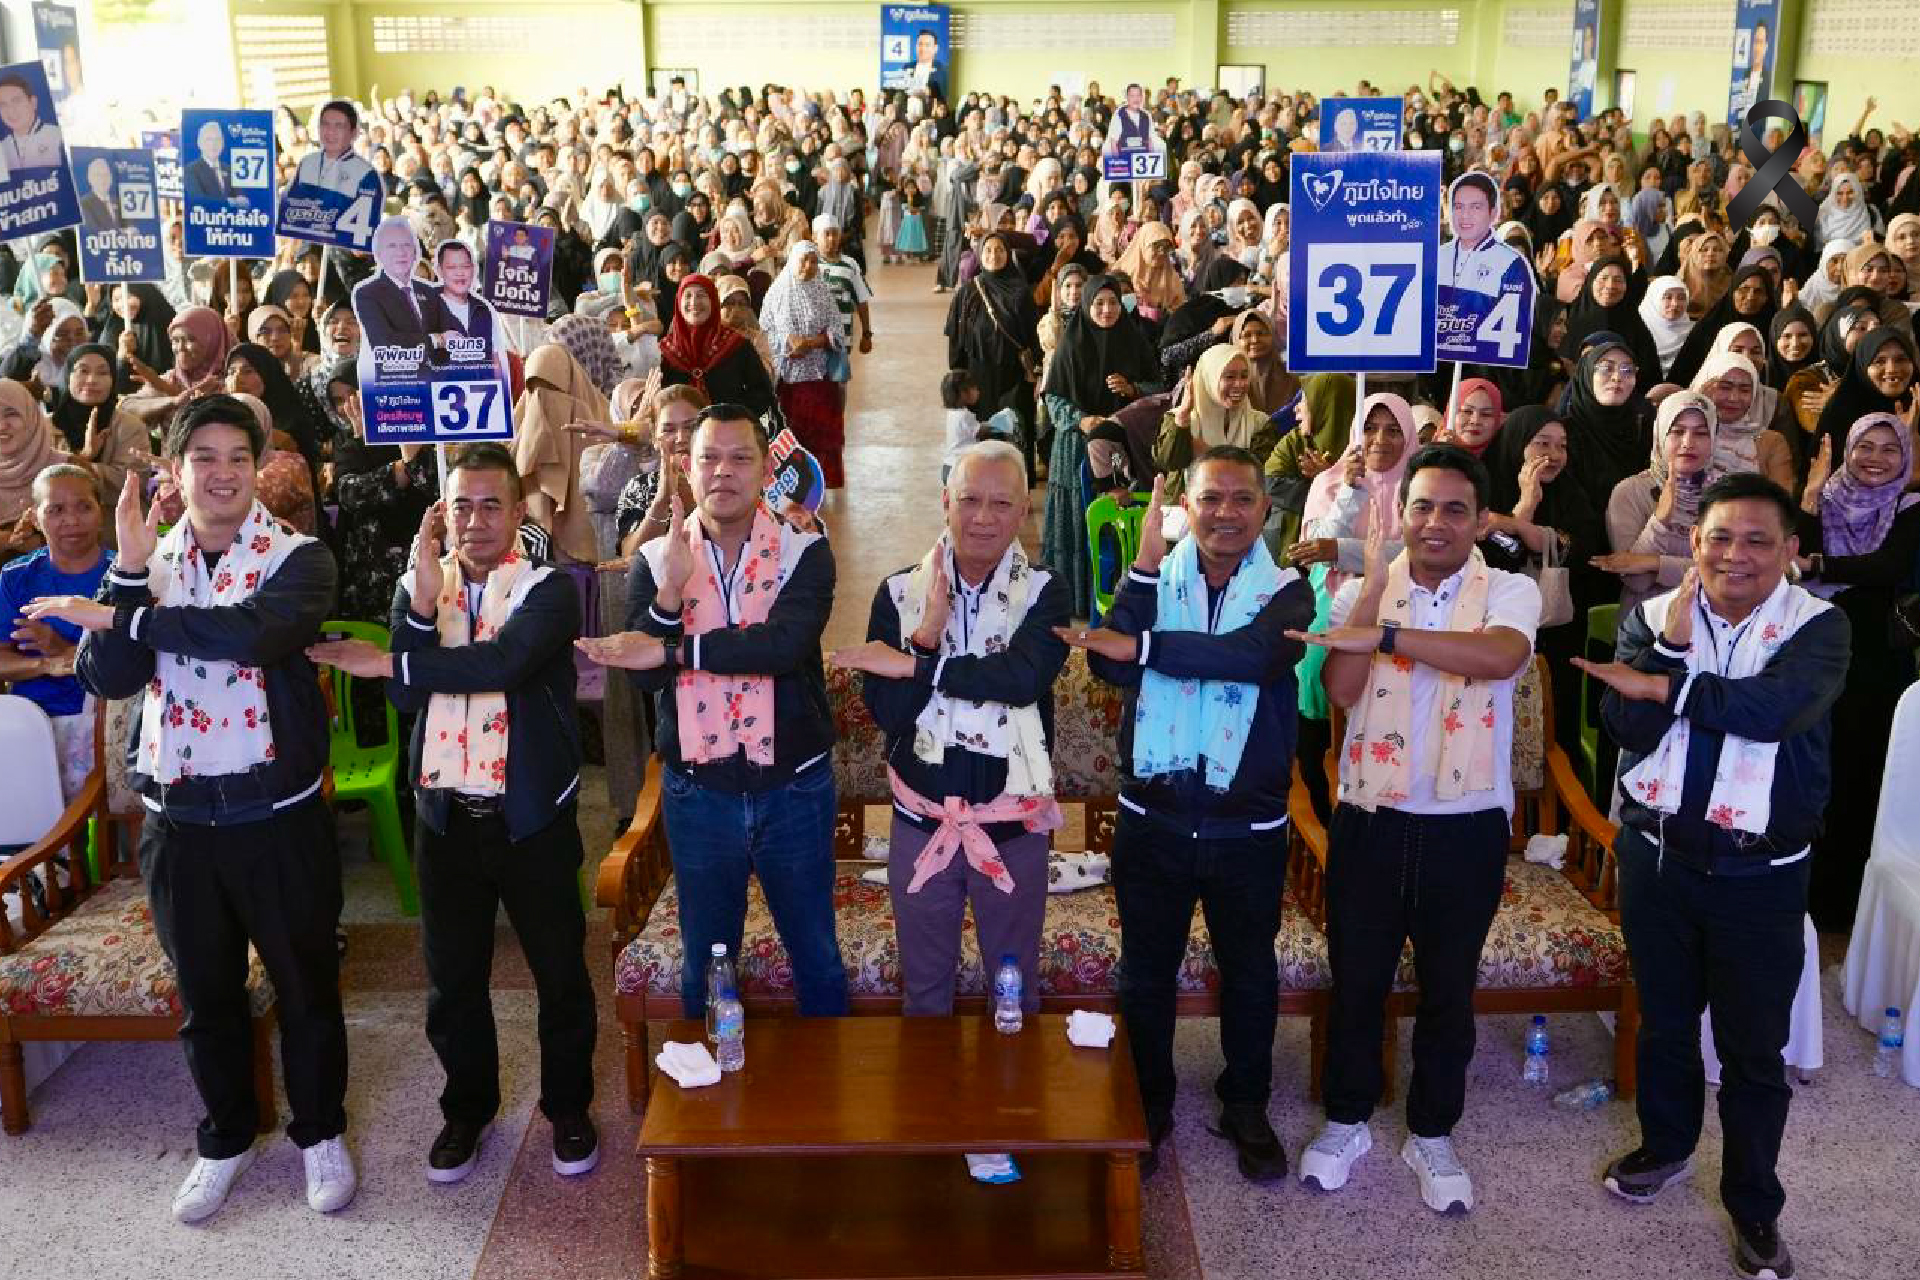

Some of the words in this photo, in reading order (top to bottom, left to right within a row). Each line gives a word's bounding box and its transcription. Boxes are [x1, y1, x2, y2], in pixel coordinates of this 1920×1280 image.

[891, 40, 902, 56] 4
[235, 155, 265, 180] 37
[1135, 155, 1161, 175] 37
[124, 190, 150, 213] 37
[1343, 178, 1424, 206] ภูมิใจไทย
[0, 200, 59, 231] ข้าสภา
[190, 205, 269, 227] เป็นกำลังใจ
[336, 196, 373, 246] 4
[1346, 210, 1407, 228] พูดแล้วทำ
[85, 227, 156, 256] ภูมิใจไทย
[205, 227, 253, 246] ให้ท่าน
[498, 260, 538, 284] ใจถึง
[494, 281, 540, 302] มือถึง
[1316, 263, 1417, 336] 37
[1476, 292, 1522, 358] 4
[447, 338, 485, 351] ธนกร
[438, 384, 498, 431] 37
